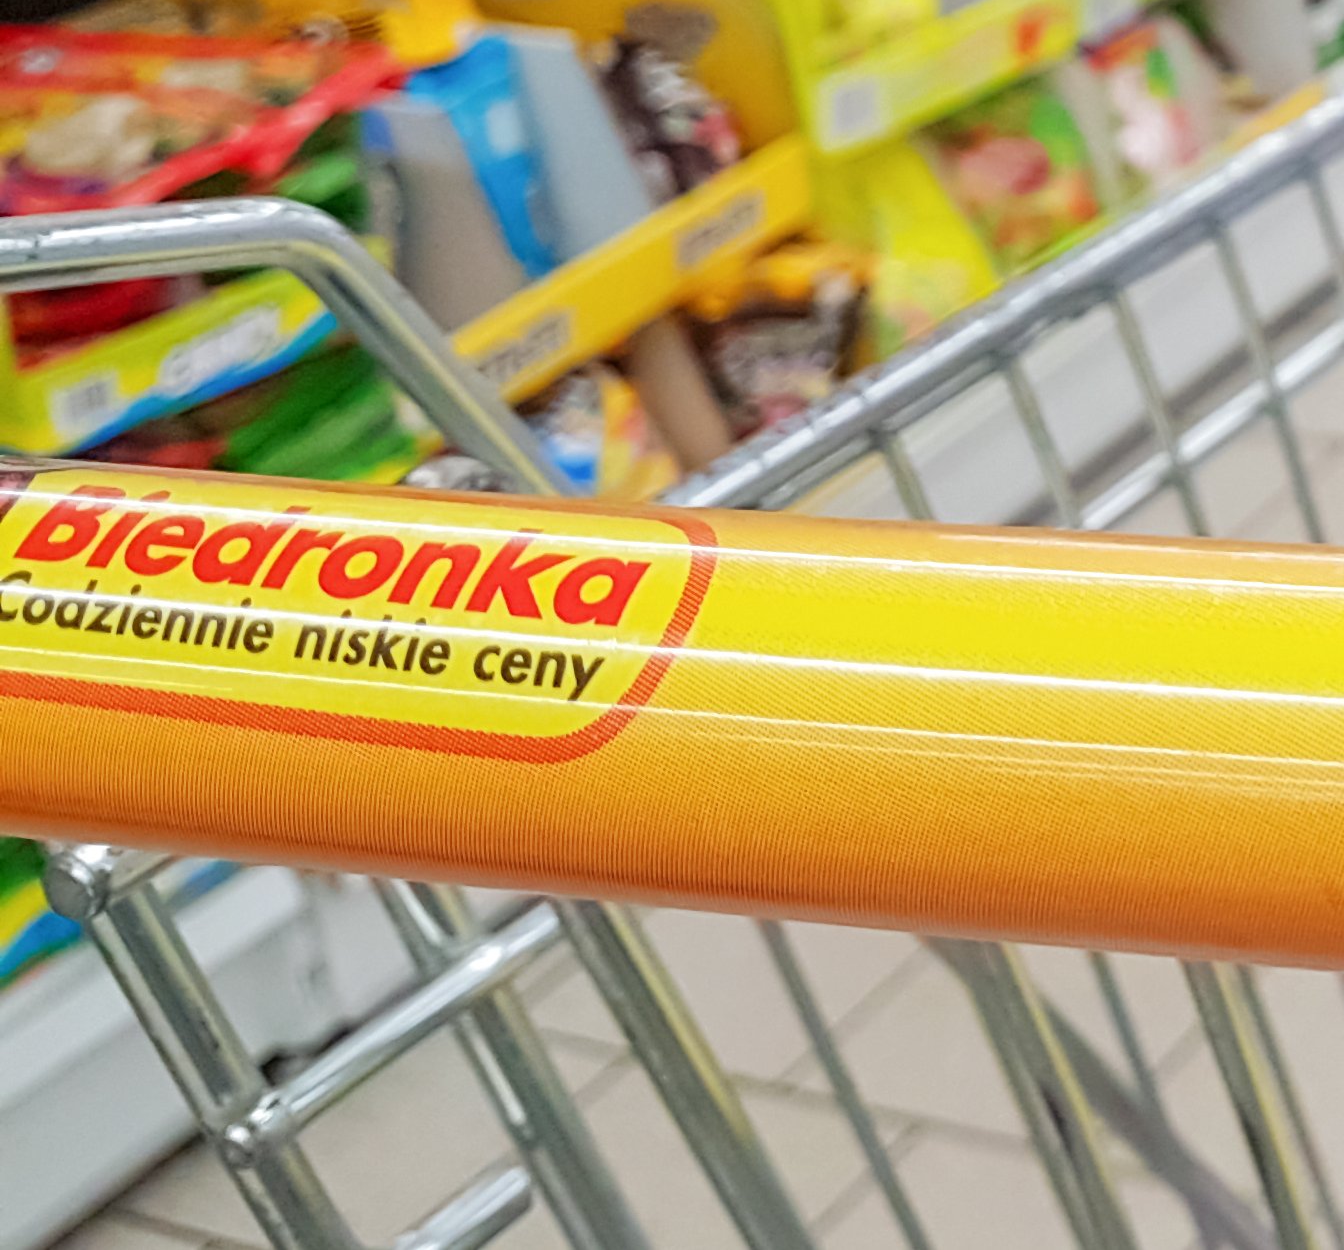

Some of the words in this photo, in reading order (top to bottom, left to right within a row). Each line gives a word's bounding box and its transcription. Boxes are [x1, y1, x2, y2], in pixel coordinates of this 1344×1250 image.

[14, 485, 652, 628] Biedronka
[0, 570, 275, 654] Codziennie
[294, 608, 451, 676] niskie
[473, 645, 606, 702] ceny
